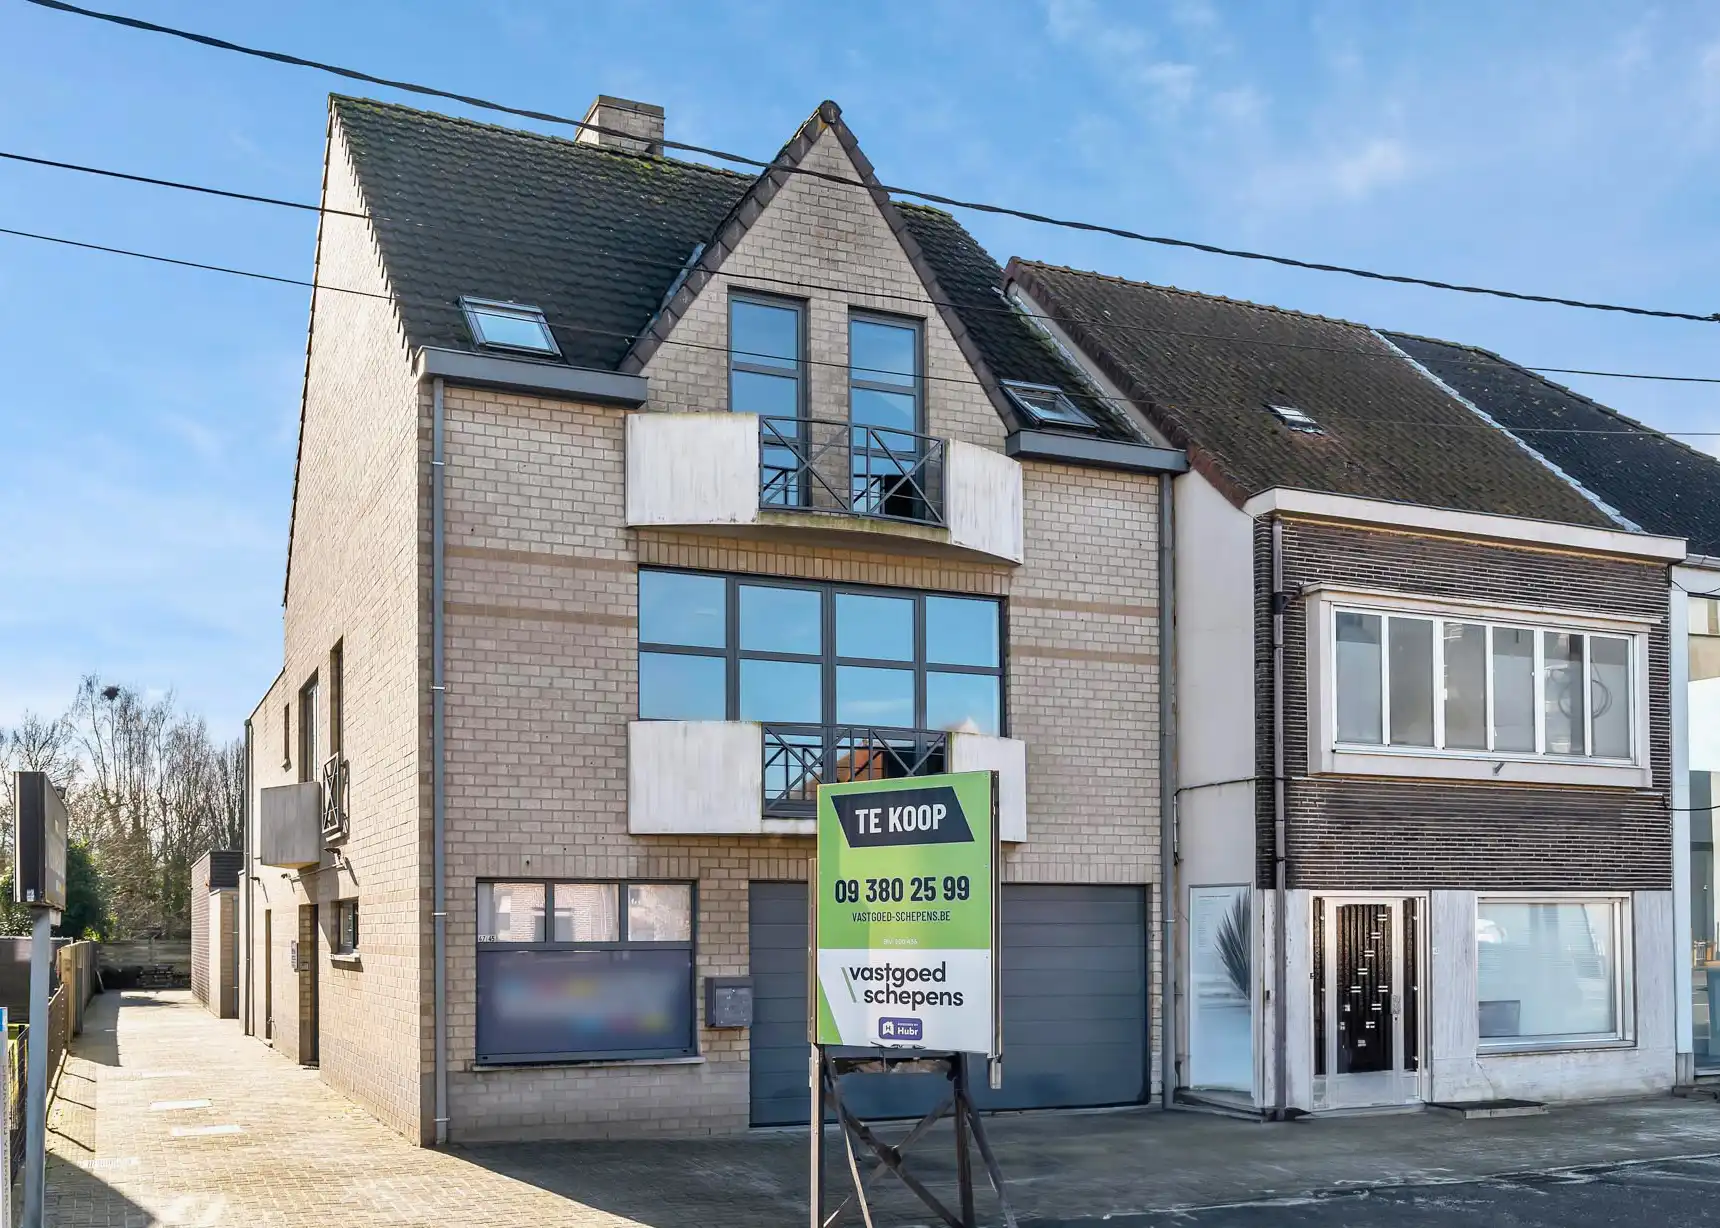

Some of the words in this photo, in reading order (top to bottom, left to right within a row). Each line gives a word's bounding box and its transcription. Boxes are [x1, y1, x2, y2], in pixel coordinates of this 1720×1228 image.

[855, 808, 882, 834] TE
[888, 803, 947, 833] KOOP
[835, 879, 859, 903] 09
[865, 877, 904, 903] 380
[910, 876, 936, 902] 25
[943, 875, 970, 901] 99
[852, 910, 951, 922] VASTGOED-SCHEPENS.BE
[849, 961, 946, 988] vastgoed
[863, 983, 964, 1011] schepens
[897, 1026, 918, 1036] Hubr
